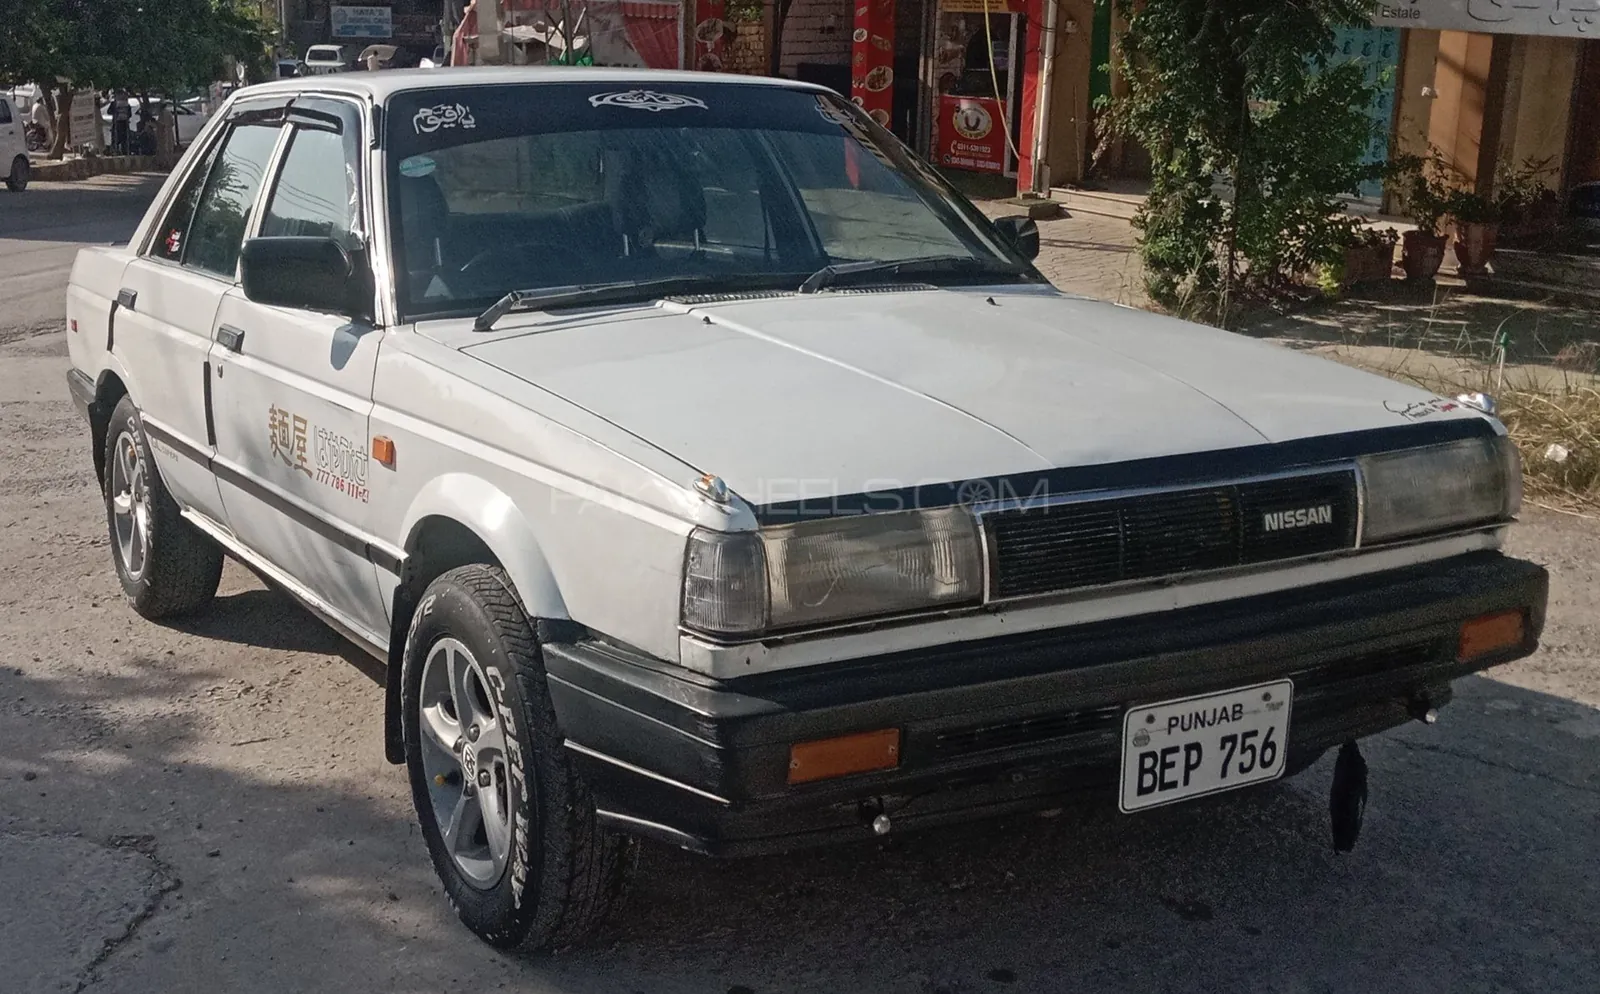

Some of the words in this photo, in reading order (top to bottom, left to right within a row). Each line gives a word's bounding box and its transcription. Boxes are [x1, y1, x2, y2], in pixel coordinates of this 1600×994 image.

[1381, 5, 1420, 19] Estate
[316, 468, 330, 484] 777
[1264, 505, 1332, 531] NISSAN
[1168, 703, 1244, 735] PUNJAB
[1137, 742, 1203, 797] BEP
[1220, 726, 1277, 779] 756
